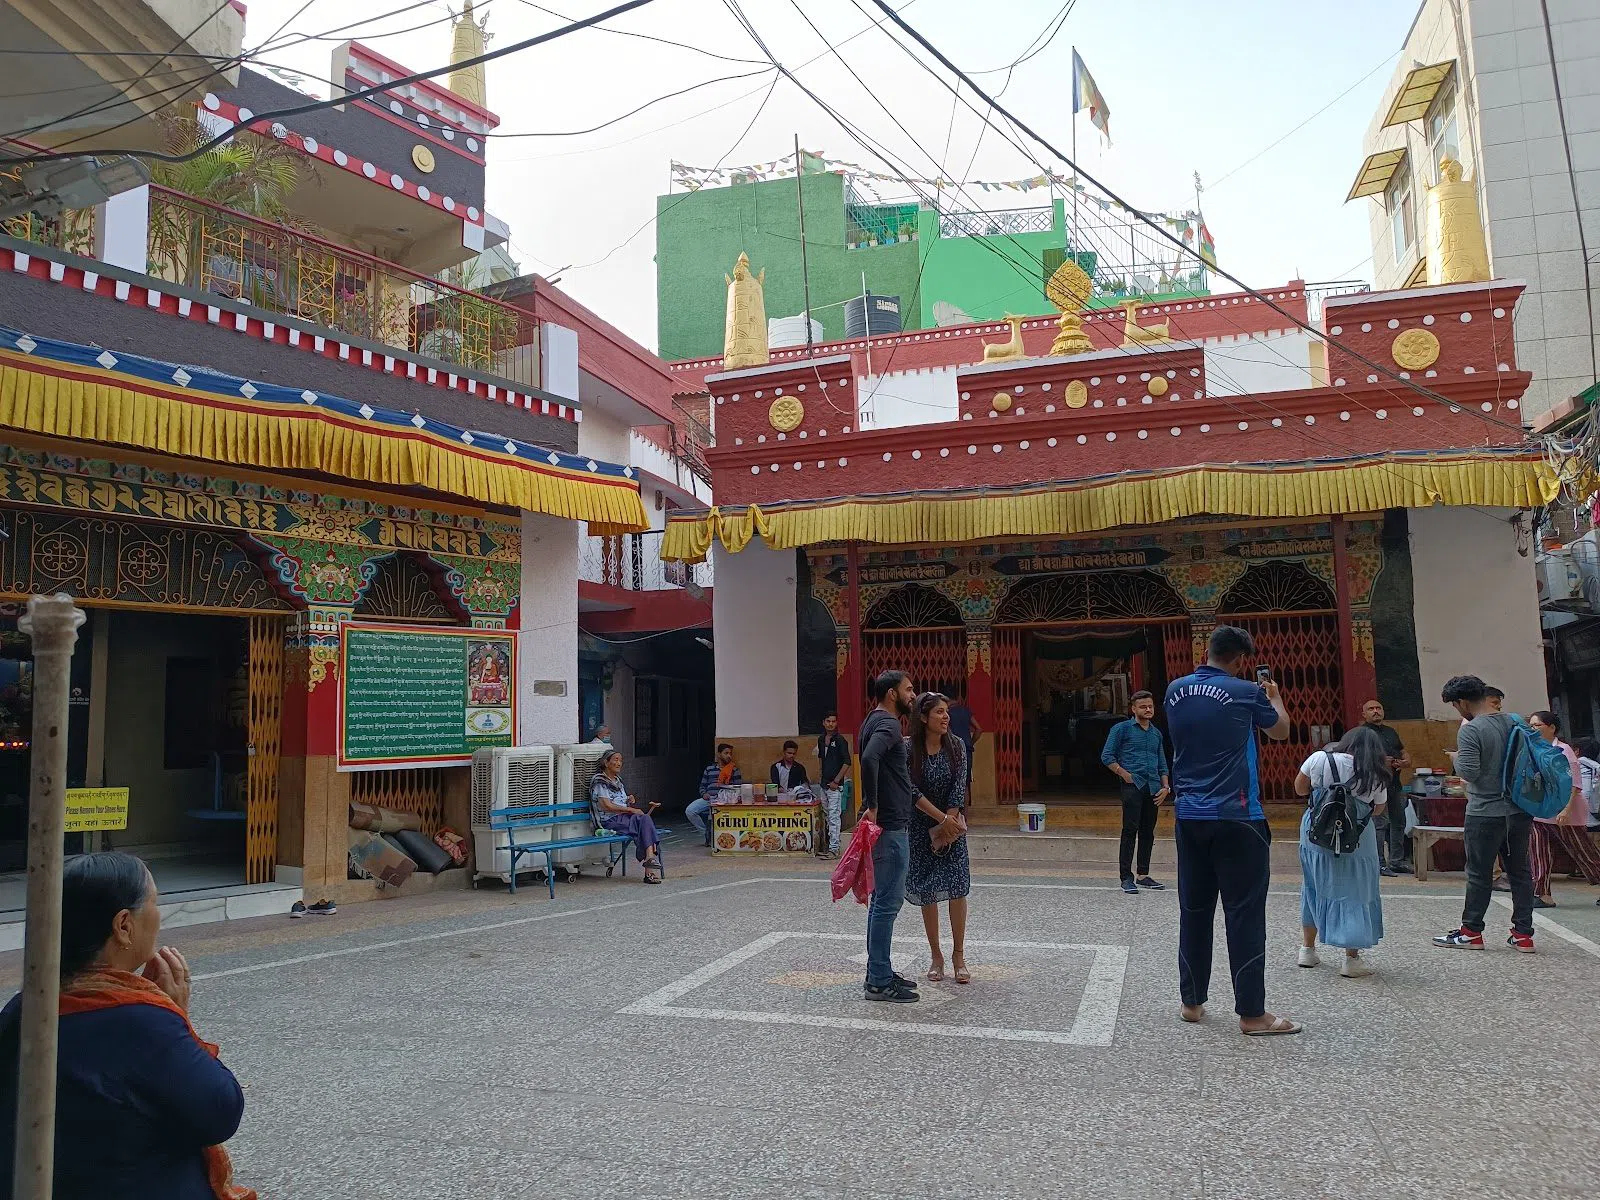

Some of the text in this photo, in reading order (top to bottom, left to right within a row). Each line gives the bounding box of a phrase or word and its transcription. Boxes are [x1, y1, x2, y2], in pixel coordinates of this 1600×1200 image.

[1188, 684, 1234, 706] UNIVERSITY
[716, 817, 808, 828] GURU LAPHING
